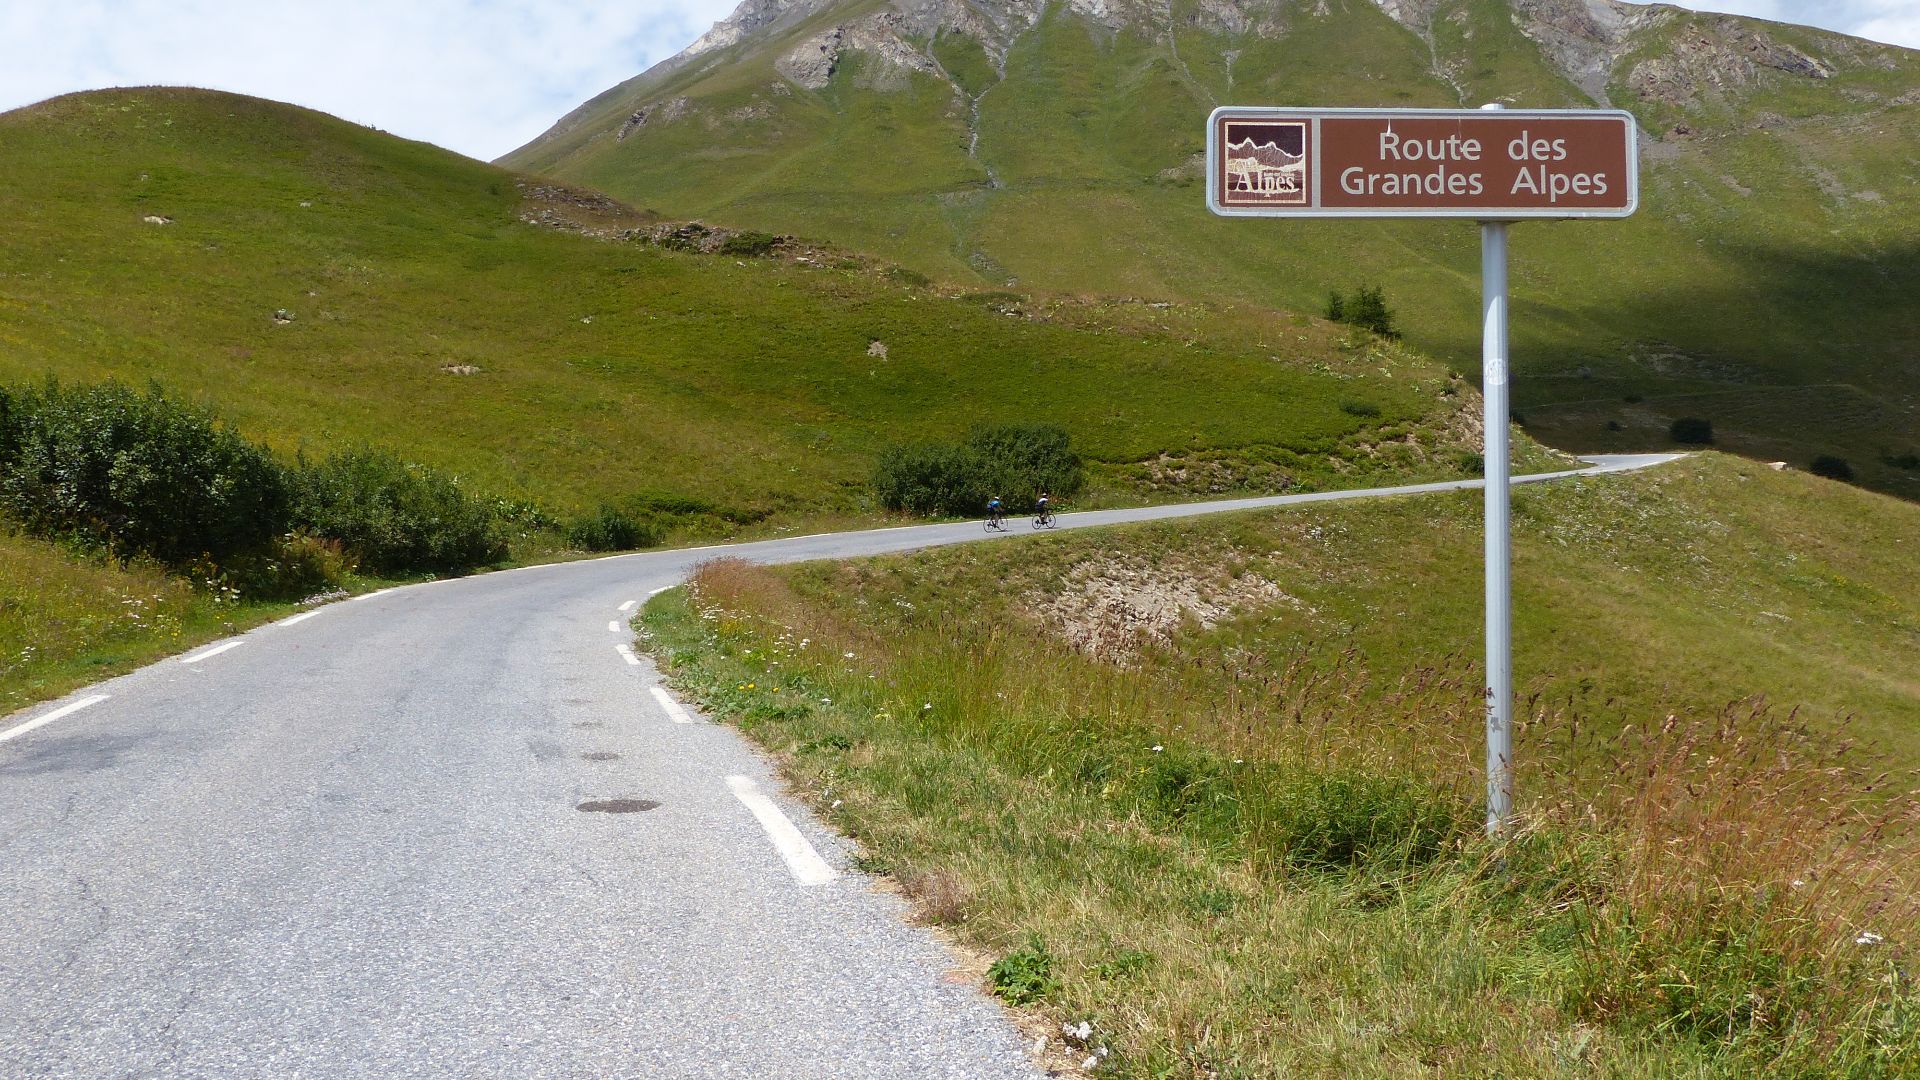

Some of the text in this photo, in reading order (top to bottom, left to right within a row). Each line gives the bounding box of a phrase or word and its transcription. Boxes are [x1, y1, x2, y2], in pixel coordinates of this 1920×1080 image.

[1380, 130, 1567, 161] Route des
[1234, 170, 1295, 198] Alpes
[1341, 165, 1608, 202] Grandes Alpes
